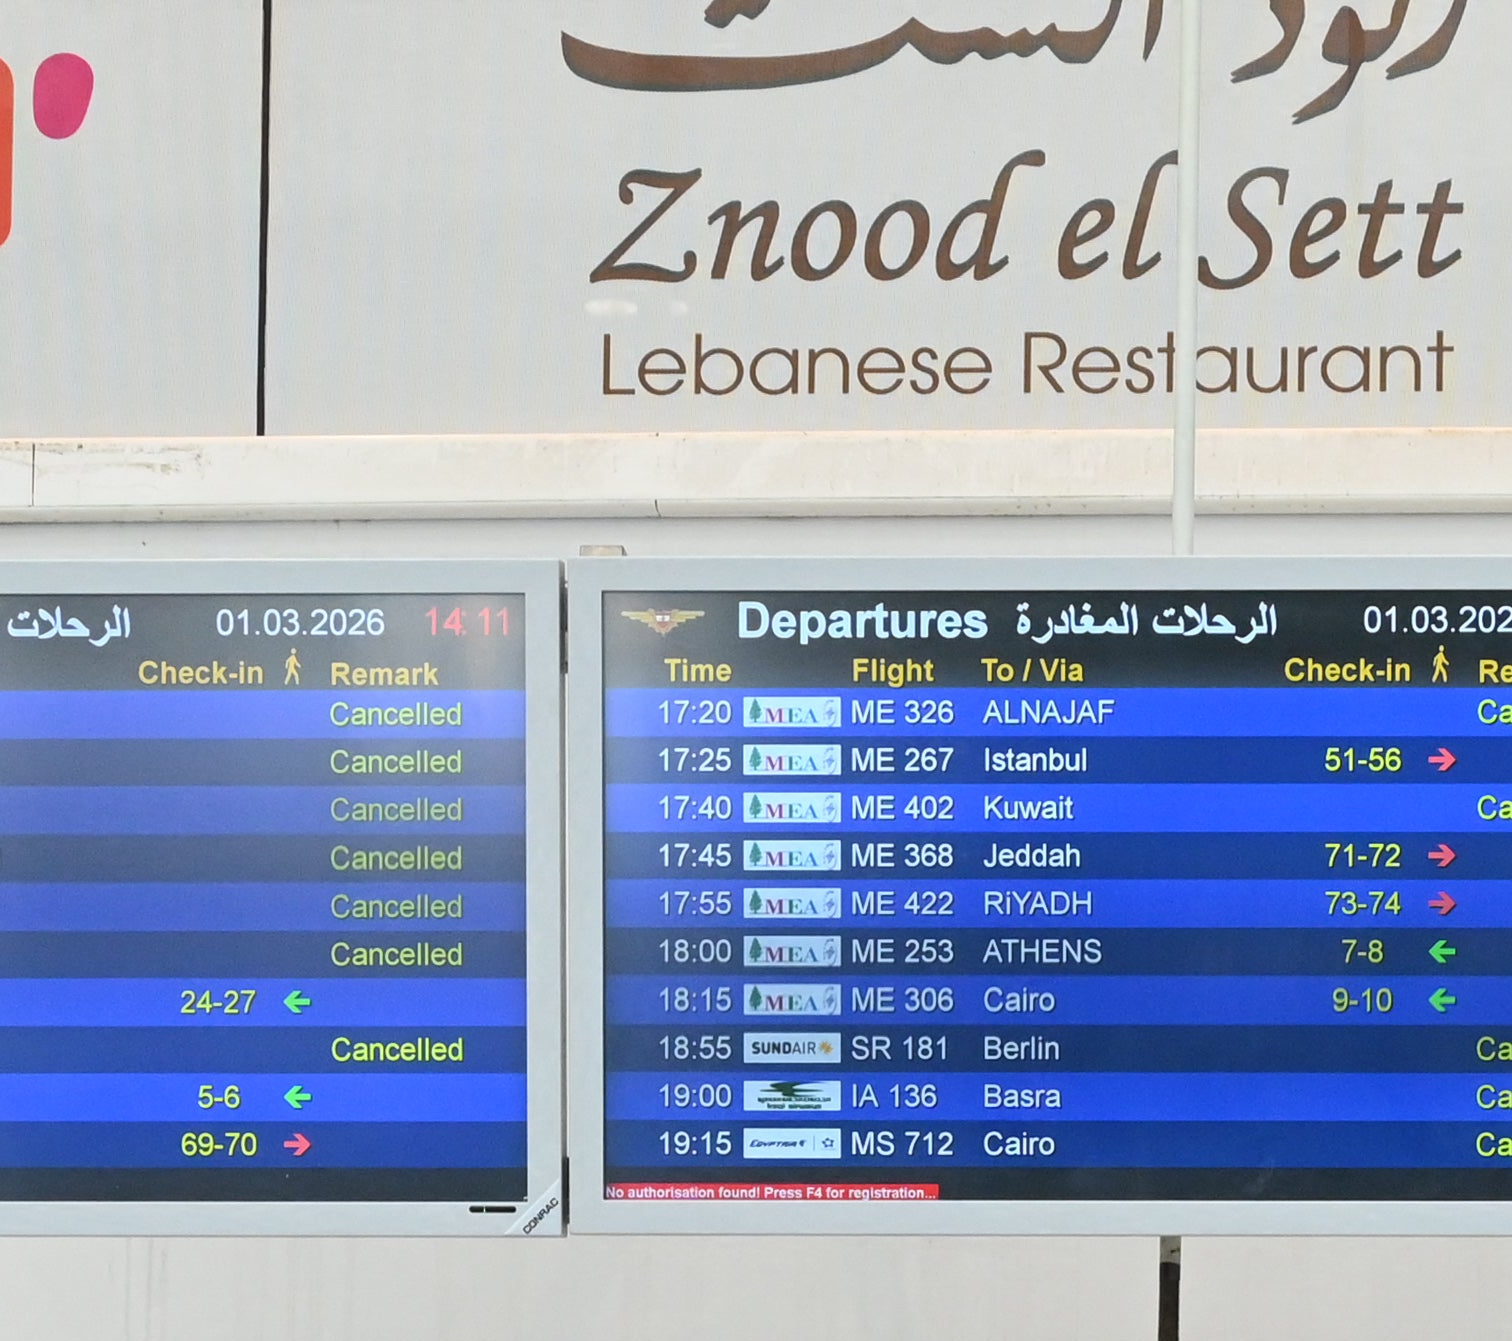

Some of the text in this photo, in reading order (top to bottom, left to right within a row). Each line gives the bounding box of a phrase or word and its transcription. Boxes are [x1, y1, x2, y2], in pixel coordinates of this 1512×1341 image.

[588, 149, 1465, 291] Znood el Sett
[602, 330, 1456, 397] Lebanese Restaurant
[7, 604, 131, 647] الرحلات
[216, 608, 385, 636] 01.03.2026
[738, 600, 989, 645] Departures
[1016, 600, 1277, 644] الرحلات المغادرة
[663, 658, 732, 682] Time
[852, 658, 935, 688] Flight
[980, 657, 1015, 682] To
[1039, 658, 1084, 682] Via
[1284, 657, 1411, 682] Check-in
[658, 699, 732, 724] 17:20
[851, 699, 895, 724] ME
[904, 699, 954, 724] 326
[982, 699, 1115, 724] ALNAJAF
[659, 890, 732, 915] 17:55
[851, 890, 895, 915] ME
[903, 890, 954, 915] 422
[1324, 890, 1401, 915] 73-74
[330, 941, 462, 967] Cancelled
[180, 989, 256, 1014] 24-27
[659, 1035, 732, 1060] 18:55
[851, 1035, 892, 1061] SR
[903, 1035, 946, 1060] 181
[984, 1035, 1060, 1060] Berlin
[751, 1041, 817, 1055] SUNDAIR
[181, 1132, 257, 1157] 69-70
[659, 1130, 732, 1155] 19:15
[851, 1130, 895, 1156] MS
[904, 1131, 954, 1156] 712
[983, 1130, 1055, 1156] Cairo
[605, 1186, 625, 1199] No
[627, 1186, 715, 1199] authorisation
[717, 1186, 761, 1199] found!
[764, 1186, 803, 1199] Press
[806, 1186, 823, 1199] F4
[825, 1186, 846, 1199] for
